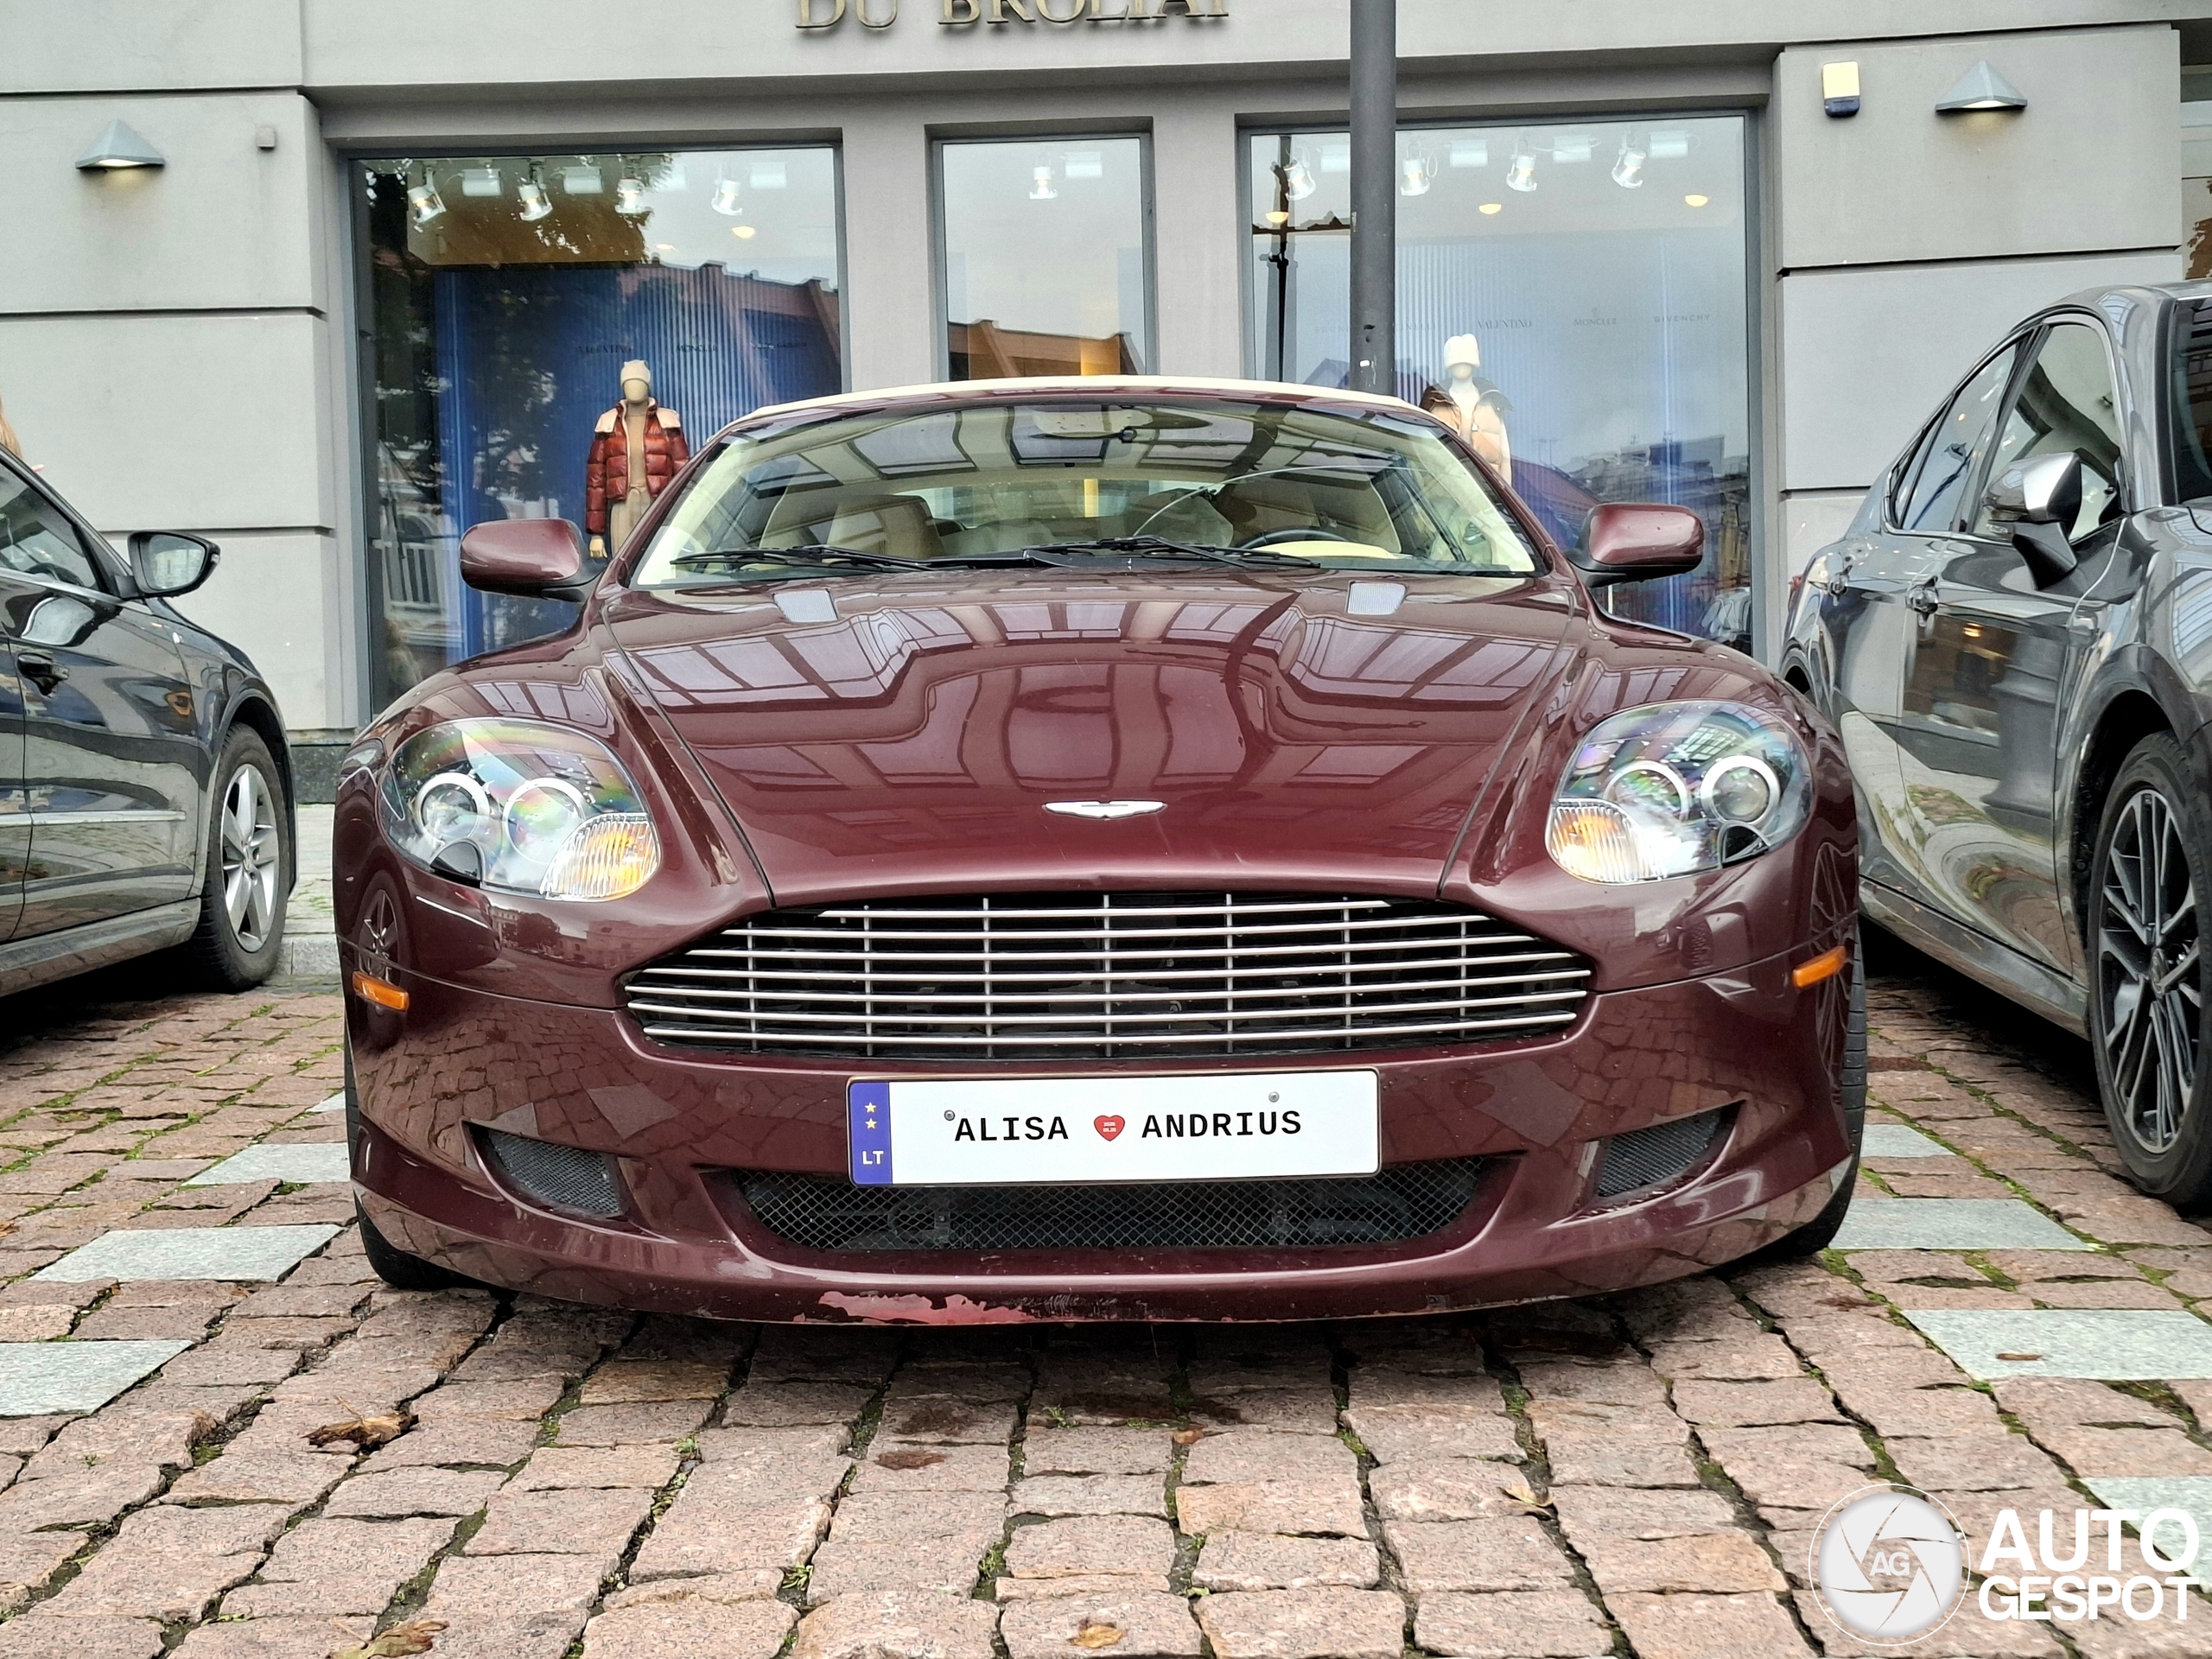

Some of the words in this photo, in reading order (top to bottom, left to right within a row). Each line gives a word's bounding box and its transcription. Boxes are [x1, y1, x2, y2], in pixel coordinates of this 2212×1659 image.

[1573, 317, 1618, 327] MONCLER
[1653, 314, 1712, 323] GIVENCHY
[1478, 319, 1533, 330] VALENTINO
[954, 1116, 1070, 1142] ALISA
[1141, 1109, 1302, 1139] ANDRIUS
[861, 1150, 884, 1166] LT
